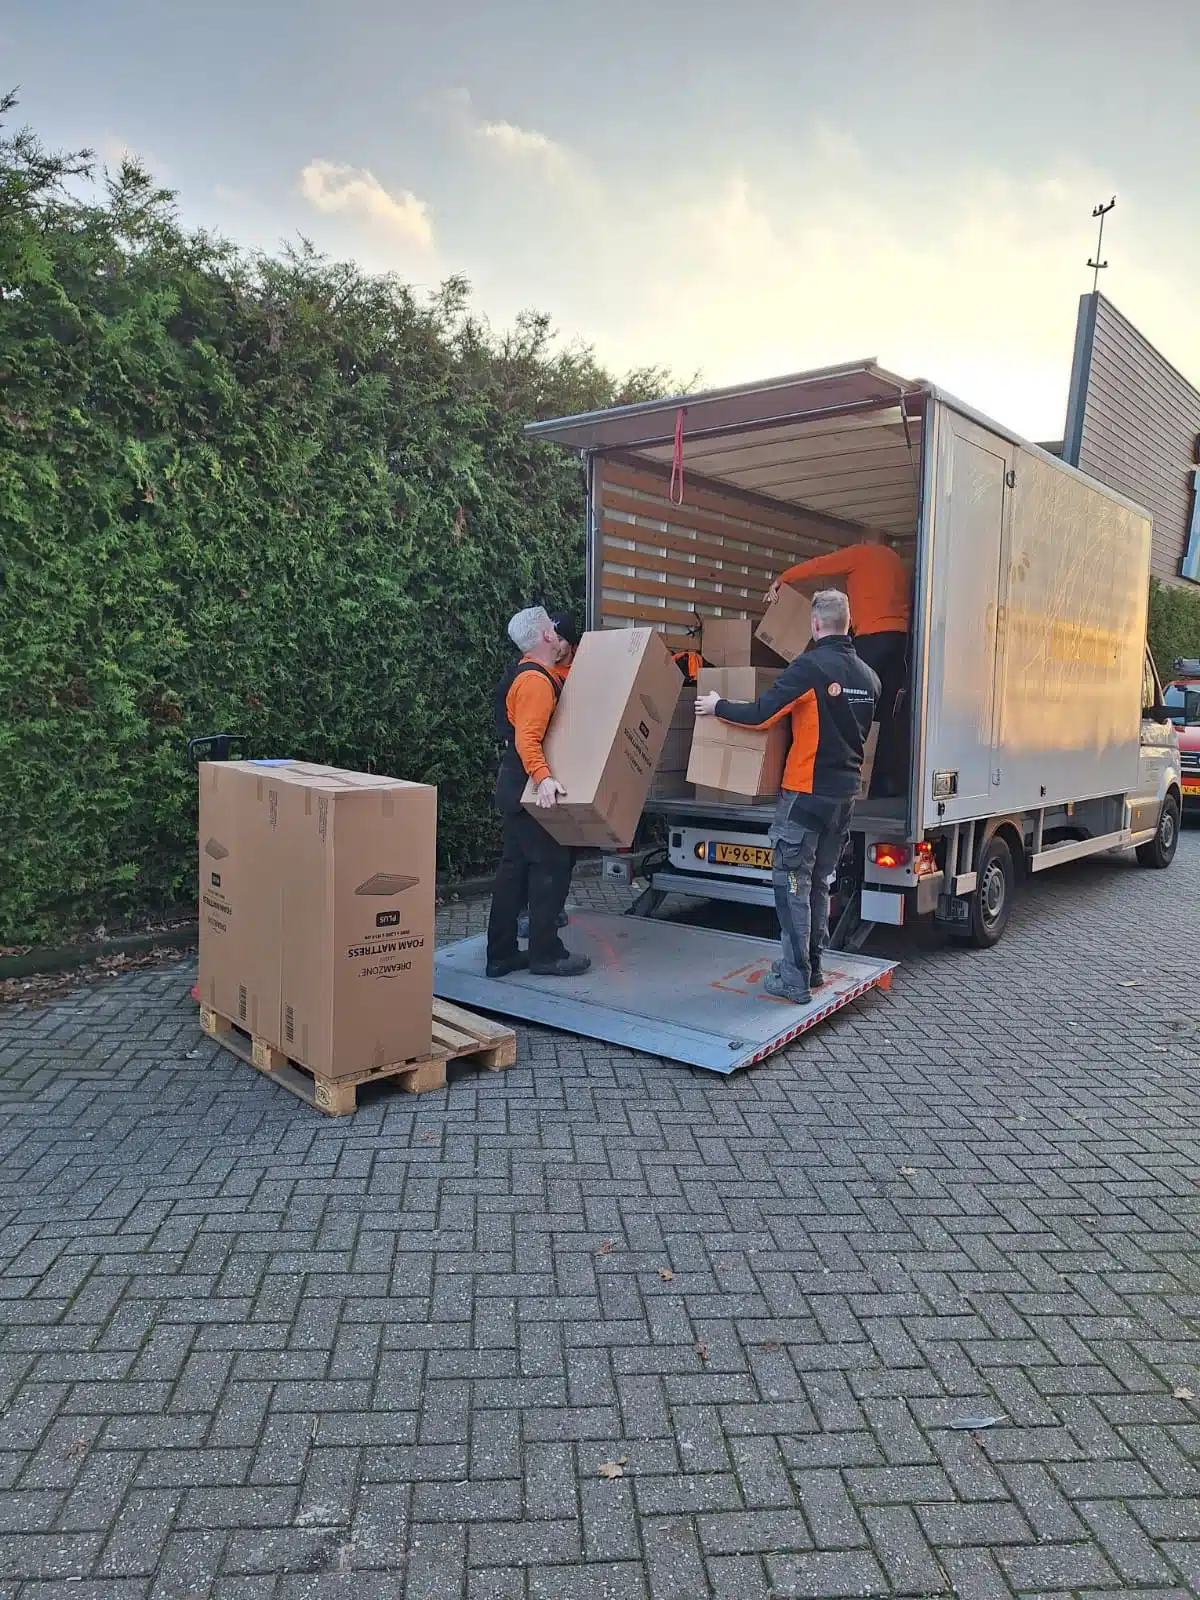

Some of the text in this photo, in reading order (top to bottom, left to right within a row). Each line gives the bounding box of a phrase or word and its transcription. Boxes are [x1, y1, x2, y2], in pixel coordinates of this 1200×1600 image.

[720, 845, 771, 865] V-96-FX
[379, 914, 397, 924] PLUS
[347, 942, 397, 958] MATTRESS
[398, 938, 424, 949] FOAM
